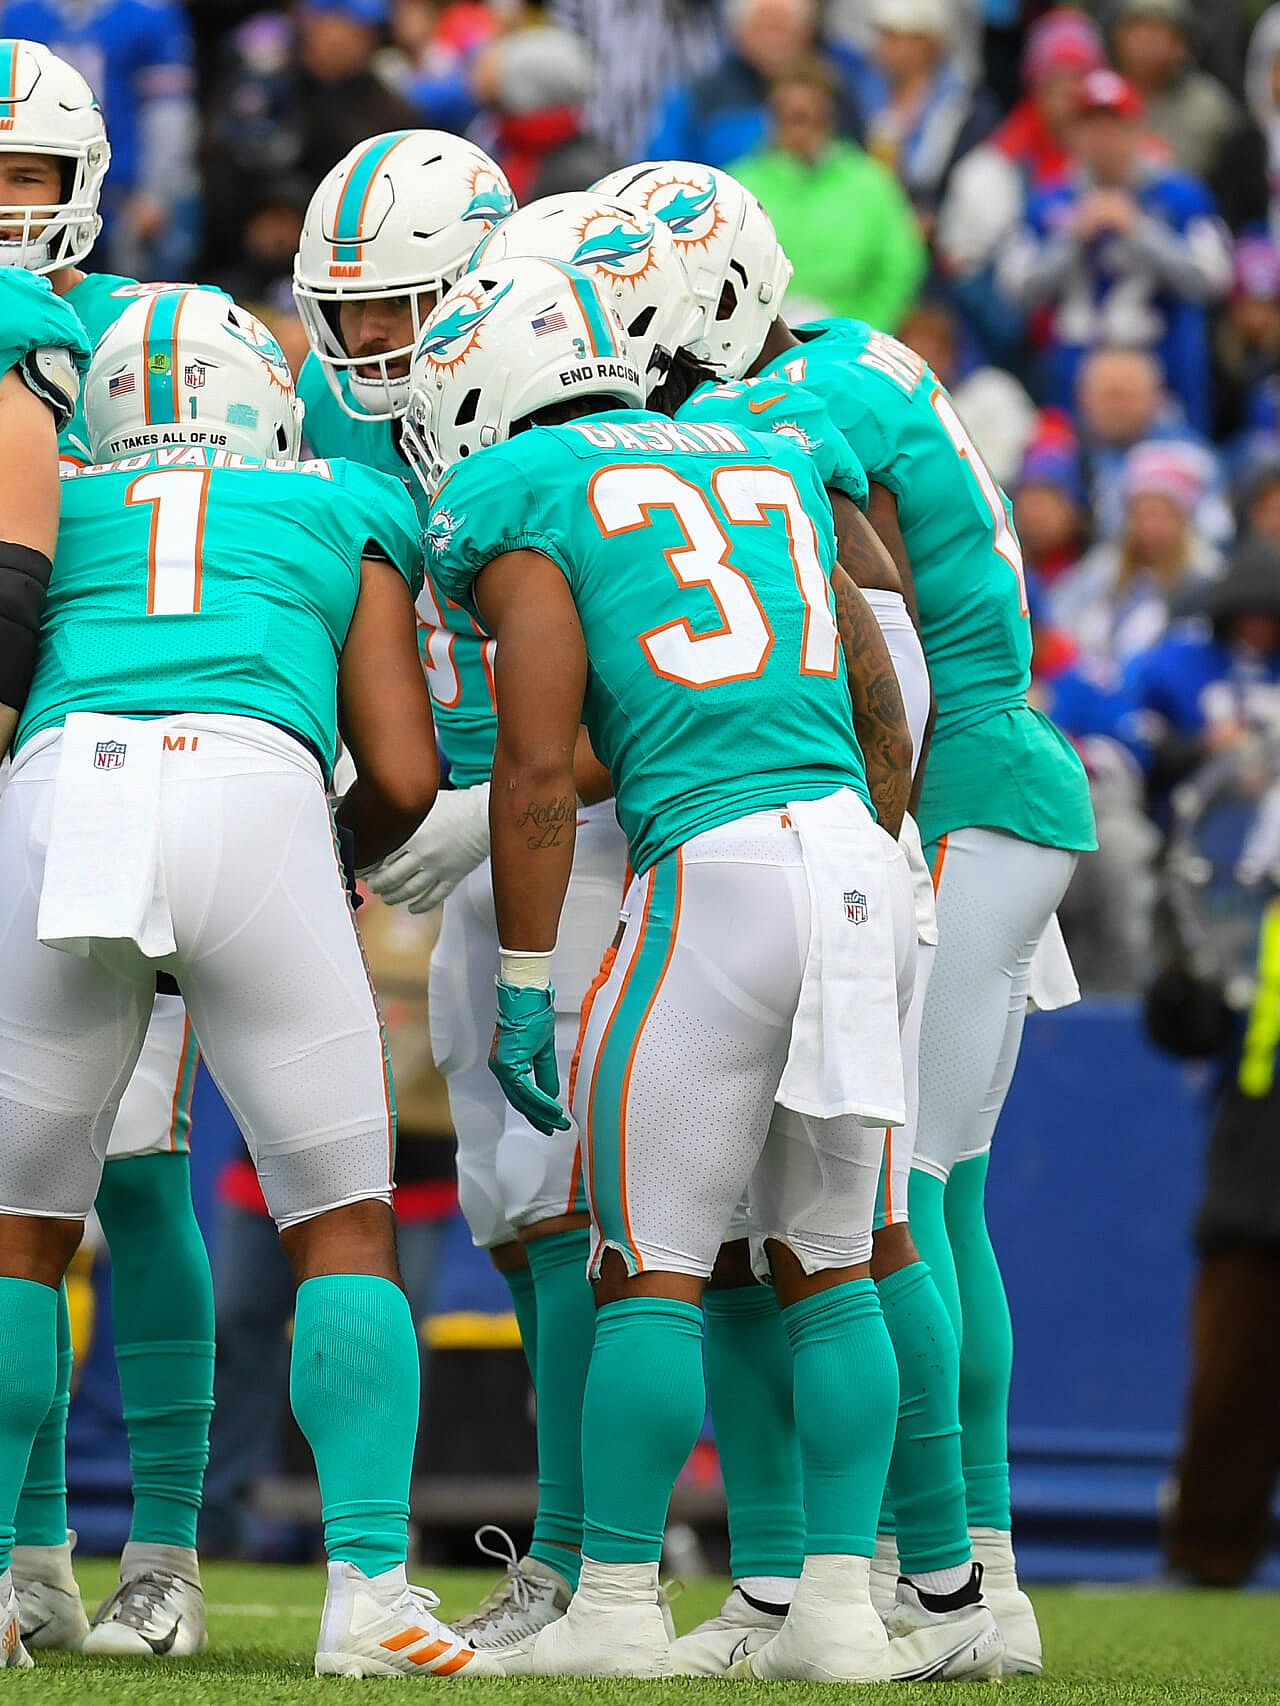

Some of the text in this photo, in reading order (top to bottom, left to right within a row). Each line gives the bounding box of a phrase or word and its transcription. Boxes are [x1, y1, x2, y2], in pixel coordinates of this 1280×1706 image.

[572, 338, 587, 360] 3
[559, 366, 594, 387] END
[188, 396, 197, 419] 1
[110, 432, 227, 454] IT TAKES ALL OF US
[566, 421, 749, 453] GASKIN
[125, 468, 212, 615] 1
[587, 463, 840, 690] 37
